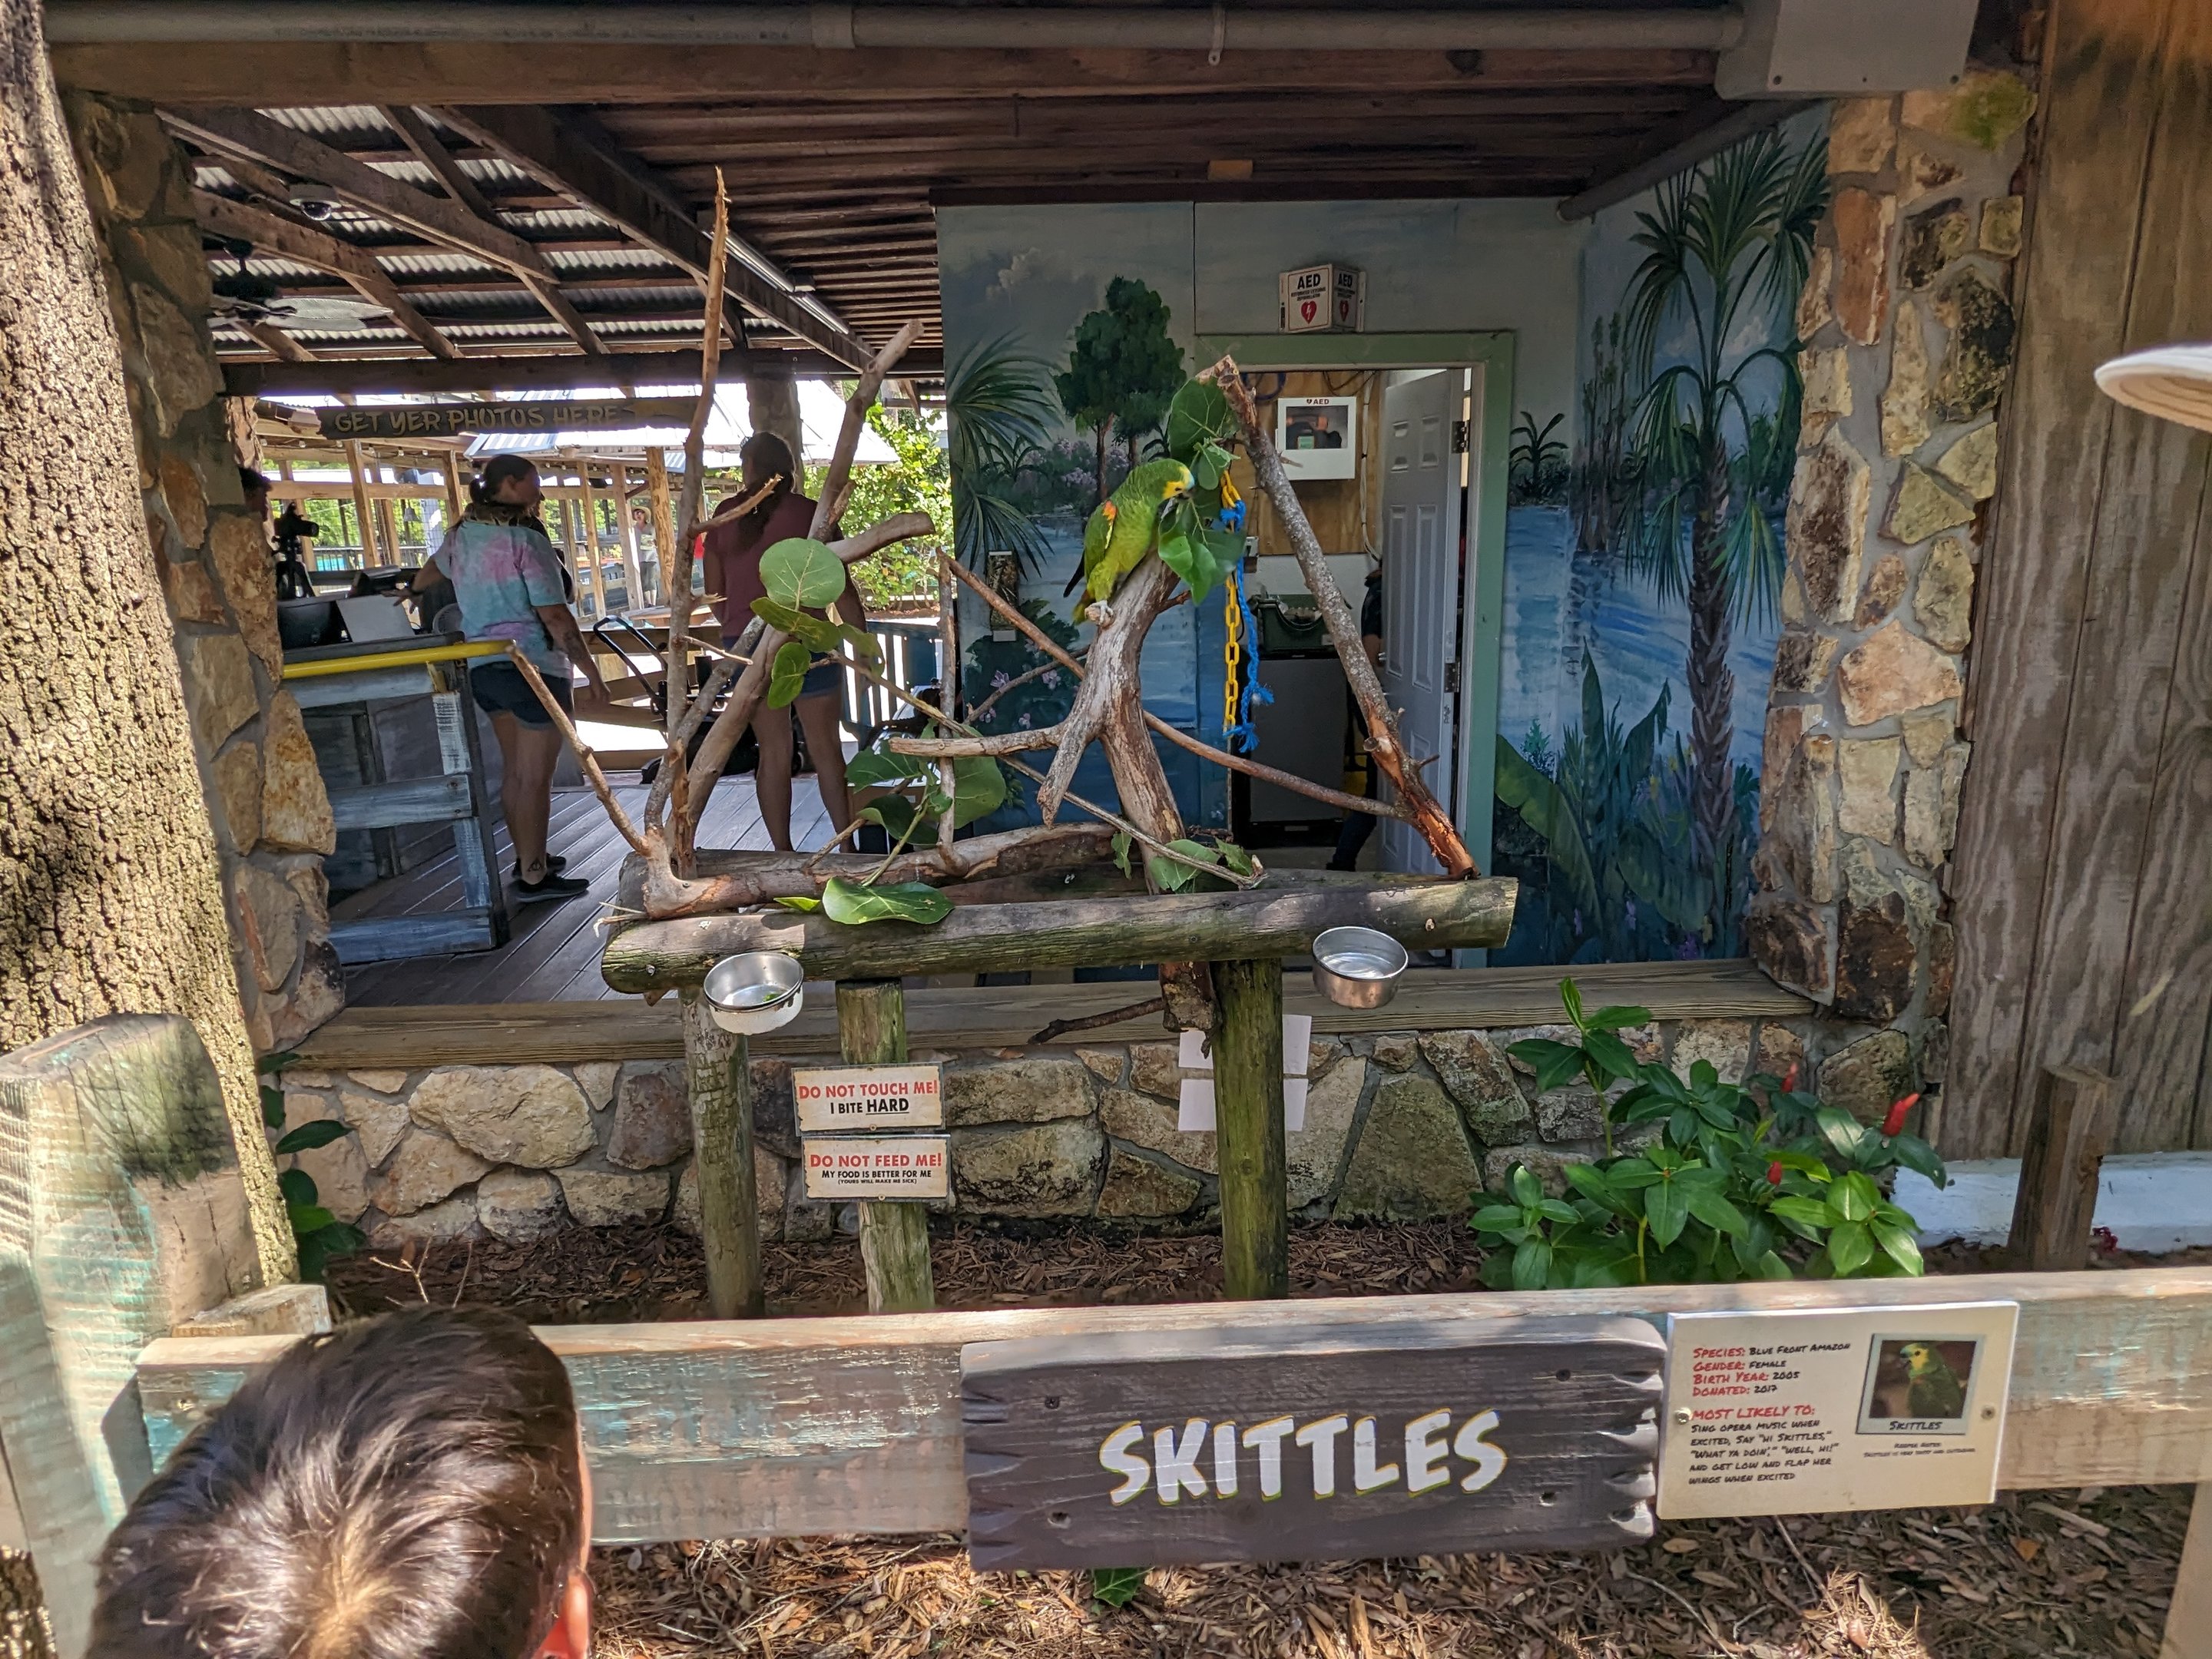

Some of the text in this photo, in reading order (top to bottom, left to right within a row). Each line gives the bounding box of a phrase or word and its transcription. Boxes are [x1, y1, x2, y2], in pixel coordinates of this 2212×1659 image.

[1297, 273, 1321, 290] AED
[1338, 273, 1353, 288] AED
[333, 405, 621, 435] GET YER PHOTOS HERE
[798, 1080, 938, 1099] DO NOT TOUCH ME!
[830, 1098, 909, 1114] I BITE HARD
[810, 1153, 942, 1167] DO NOT FEED ME!
[1693, 1343, 1851, 1358] SPECIES: BLUE FRONT AMAZON
[1693, 1360, 1786, 1372] GENDER: FEMALE
[1693, 1371, 1801, 1385] BIRTH YEAR: 2005
[1693, 1385, 1777, 1396] DONATED: 2017
[1691, 1405, 1815, 1420] MOST LIKELY TO:
[1690, 1425, 1717, 1433] SING
[1757, 1421, 1787, 1430] MUSIC
[1791, 1419, 1820, 1429] WHEN
[1889, 1421, 1942, 1430] SKITTLES
[1690, 1438, 1730, 1446] EXCITED,
[1736, 1435, 1755, 1444] SAY
[1098, 1408, 1509, 1506] SKITTLES
[1712, 1462, 1734, 1471] GET
[1689, 1473, 1795, 1485] WINGS WHEN EXCITED
